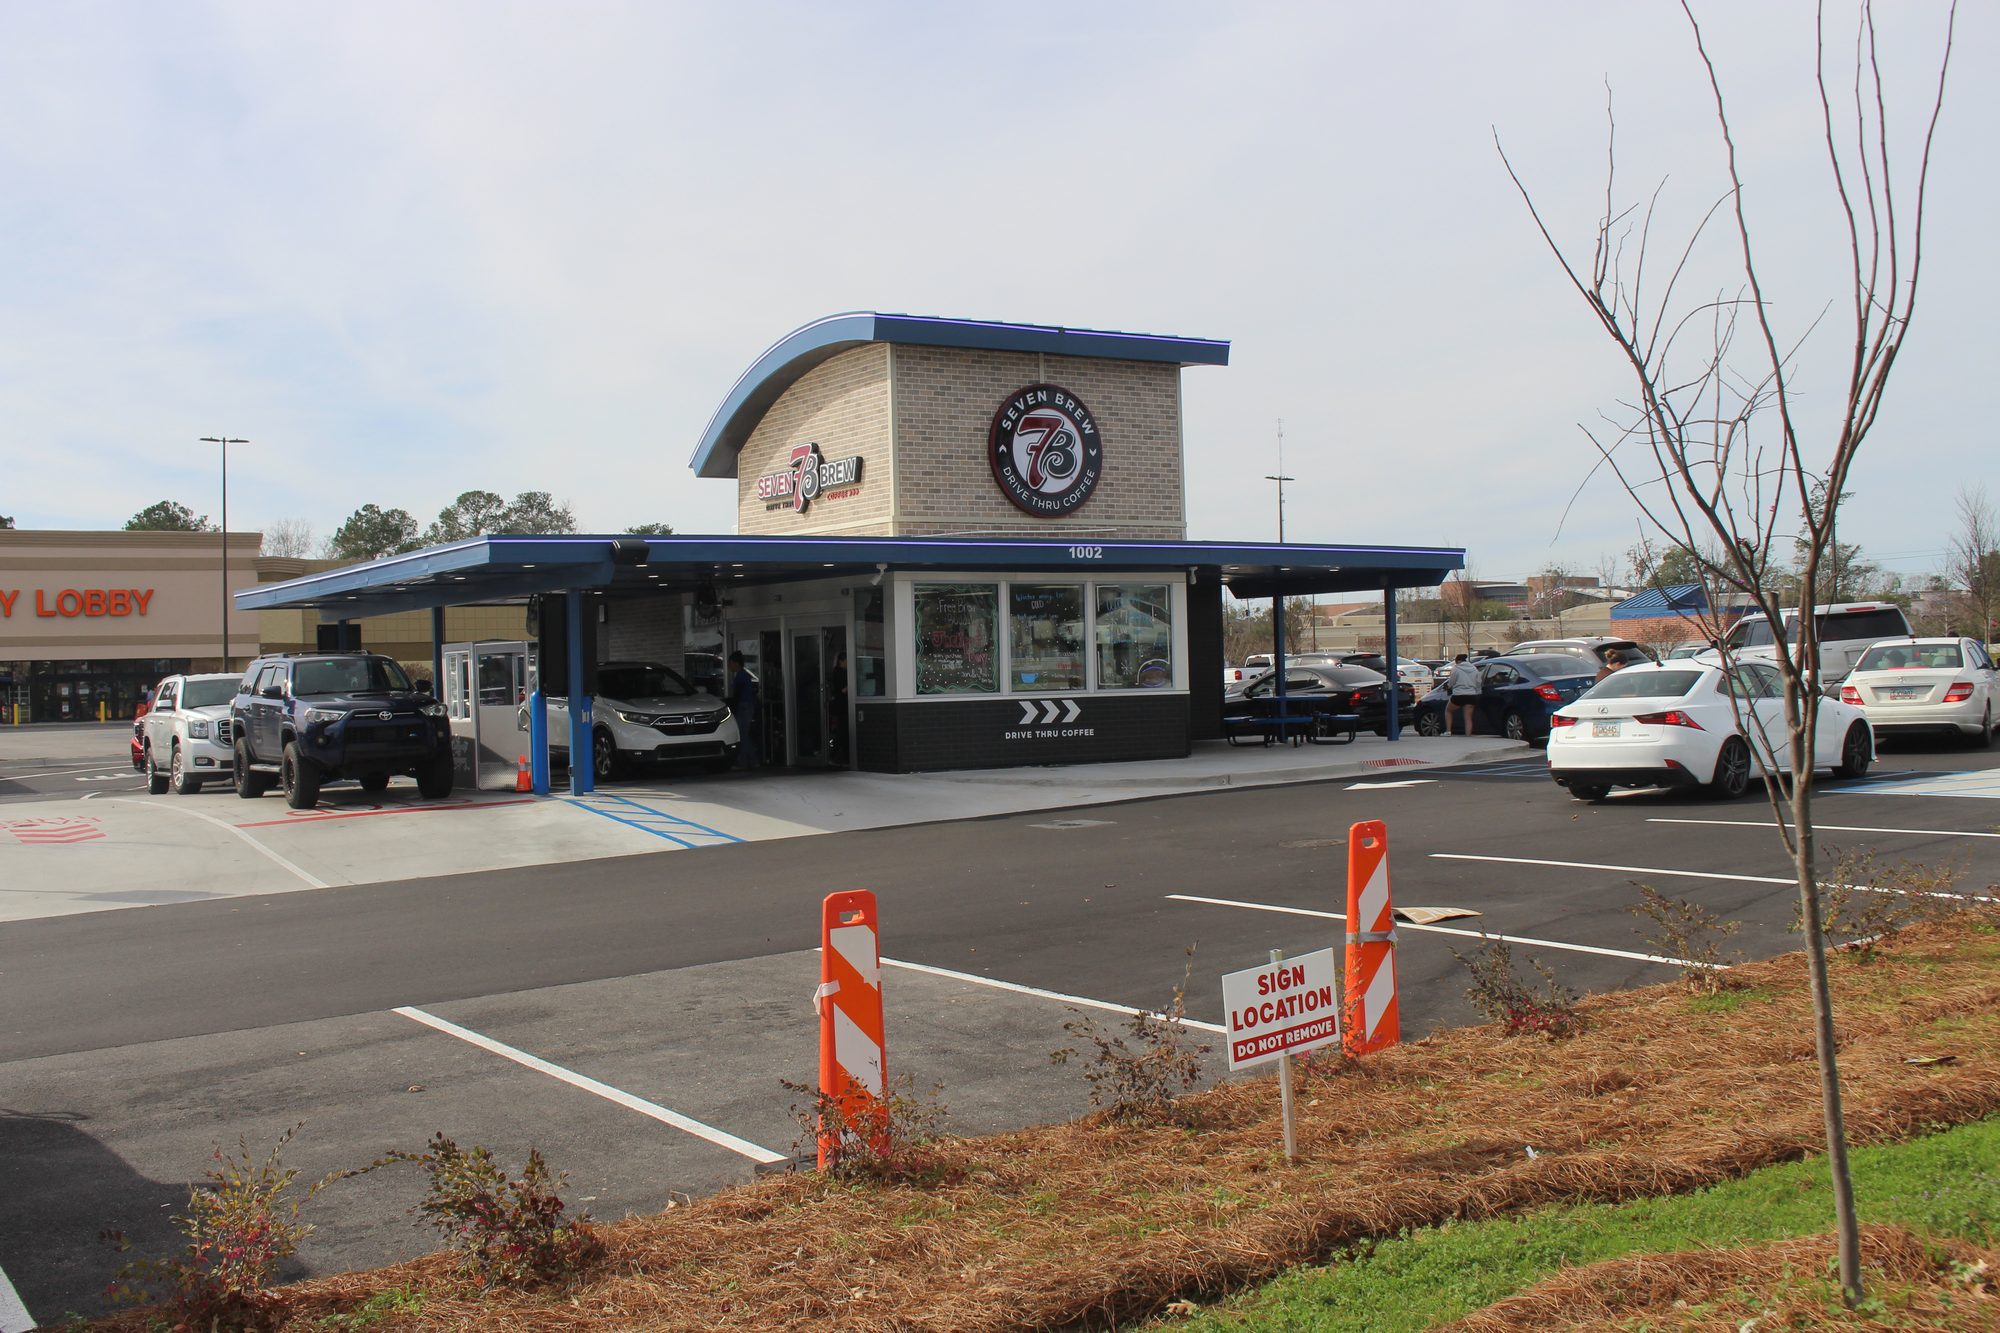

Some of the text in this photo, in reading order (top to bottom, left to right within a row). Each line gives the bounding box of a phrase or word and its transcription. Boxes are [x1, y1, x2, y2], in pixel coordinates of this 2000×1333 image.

[1002, 390, 1095, 435] SEVEN BREW
[758, 456, 858, 499] SEVEN BREW
[1003, 466, 1096, 510] DRIVE THRU COFFEE
[1069, 546, 1102, 559] 1002
[35, 589, 155, 617] LOBBY
[1005, 728, 1095, 740] DRIVE THRU COFFEE
[1257, 965, 1305, 996] SIGN
[1232, 986, 1332, 1032] LOCATION
[1237, 1020, 1333, 1058] DO NOT REMOVE
